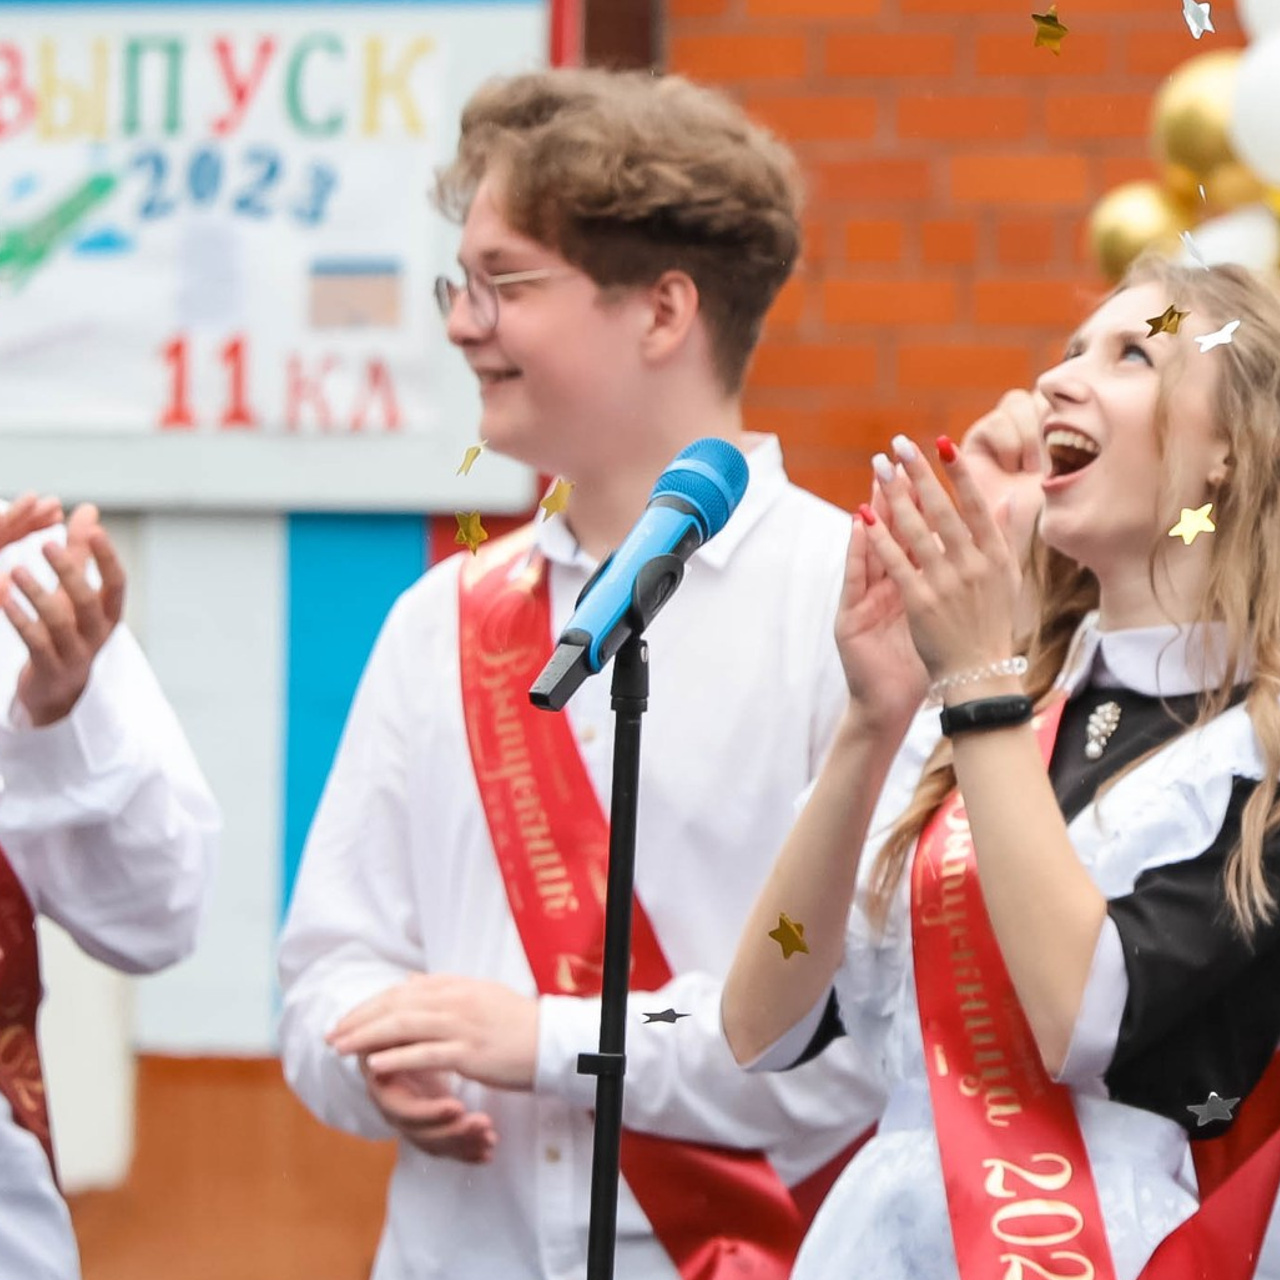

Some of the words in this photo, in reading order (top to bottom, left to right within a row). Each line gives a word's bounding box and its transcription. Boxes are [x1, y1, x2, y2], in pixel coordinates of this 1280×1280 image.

[0, 30, 436, 141] ВЫПУСК
[130, 147, 338, 227] 2023
[157, 331, 258, 432] 11
